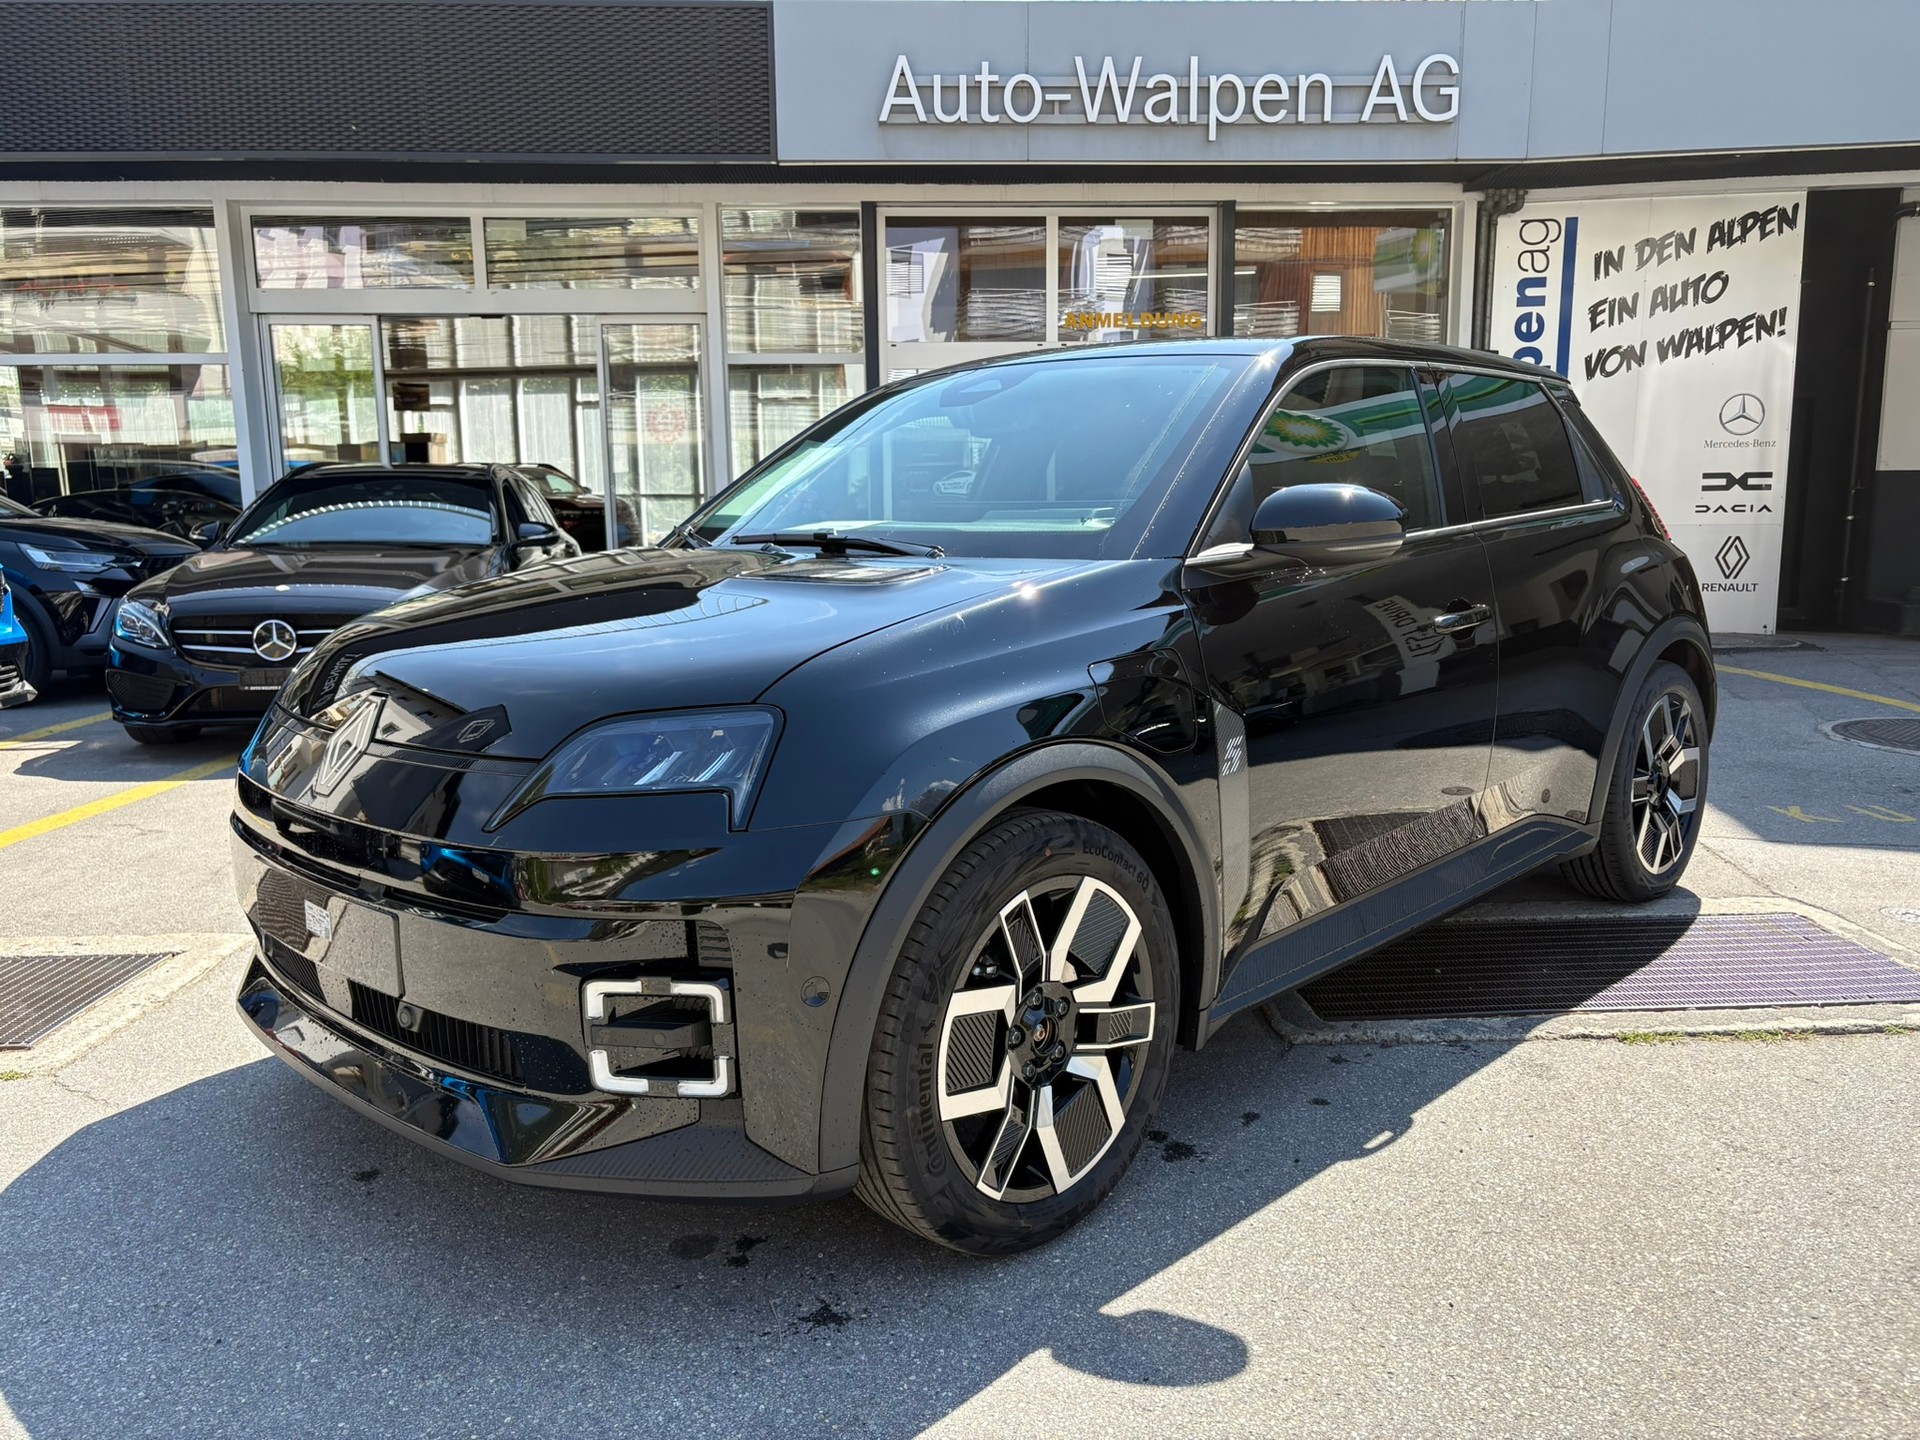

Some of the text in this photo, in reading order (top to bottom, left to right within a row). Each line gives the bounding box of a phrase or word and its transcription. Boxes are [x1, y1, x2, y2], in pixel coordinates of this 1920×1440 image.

[878, 53, 1461, 142] Auto-Walpen AG
[1594, 202, 1800, 282] IN DEN ALPEN
[1065, 311, 1203, 330] ANMELDUNG
[1587, 270, 1730, 334] EIN AUTO
[1584, 306, 1788, 382] VON WALPEN!
[1703, 439, 1777, 449] Mercedes-Benz
[1695, 504, 1773, 513] DACIA
[1701, 582, 1759, 593] RENAULT
[1082, 844, 1138, 878] EcoContact
[917, 1042, 948, 1178] Continental
